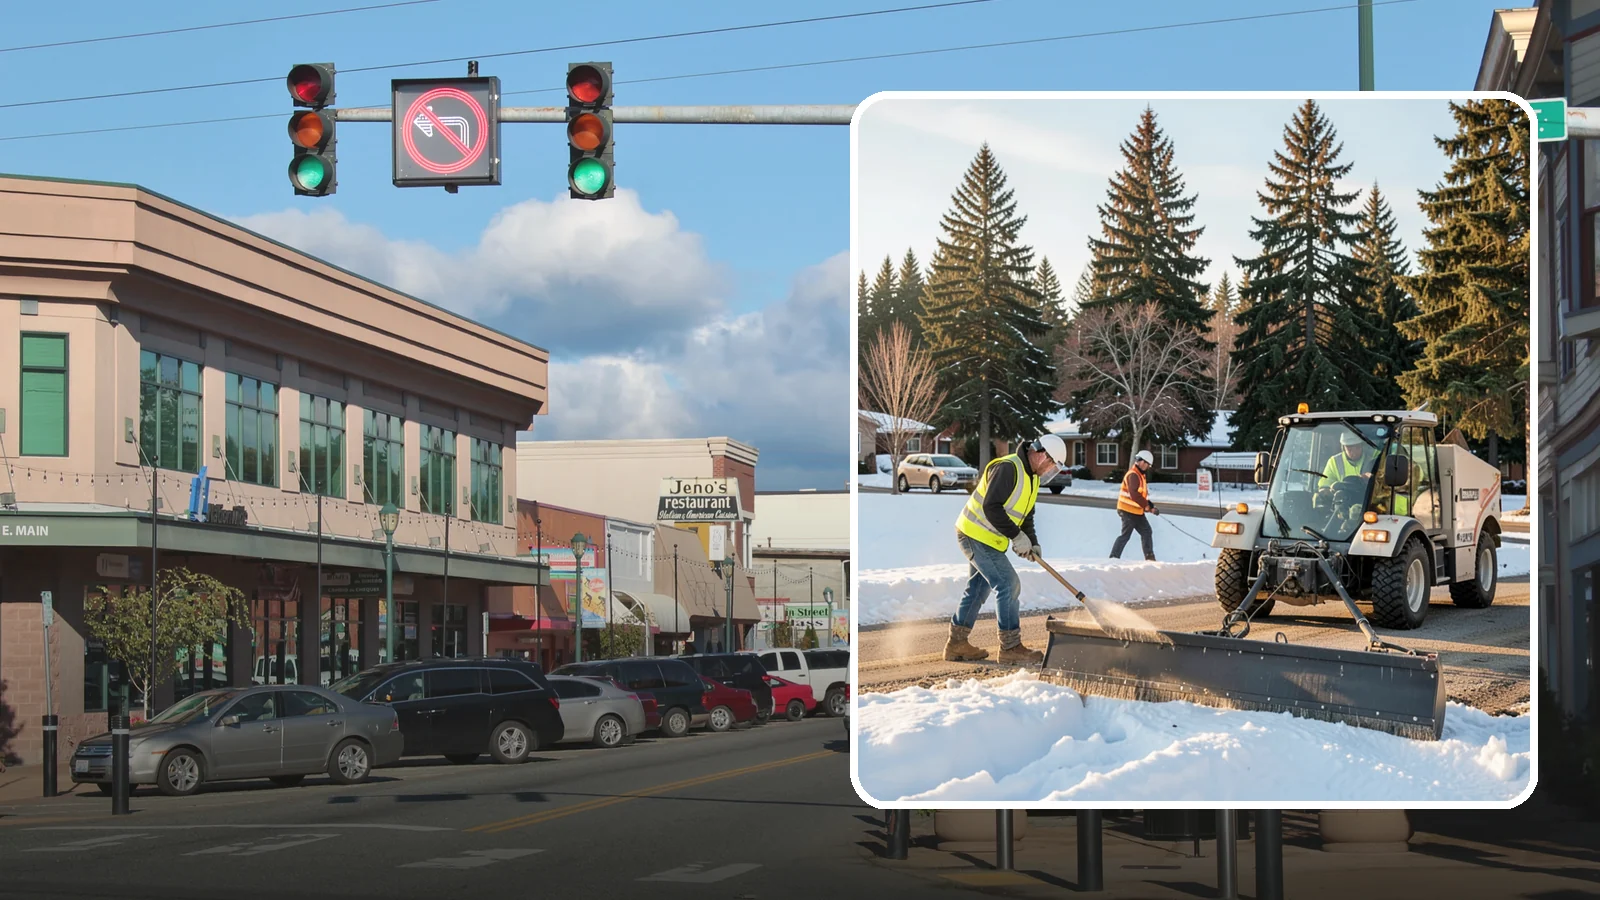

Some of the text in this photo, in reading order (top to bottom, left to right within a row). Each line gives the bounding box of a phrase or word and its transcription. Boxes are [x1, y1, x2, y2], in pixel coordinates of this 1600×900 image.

[669, 480, 728, 494] Jeno's
[665, 496, 731, 509] restaurant
[658, 510, 681, 519] Italian
[686, 510, 714, 519] American
[715, 510, 737, 519] Cuisine
[2, 525, 49, 536] E. MAIN
[798, 608, 828, 616] Street
